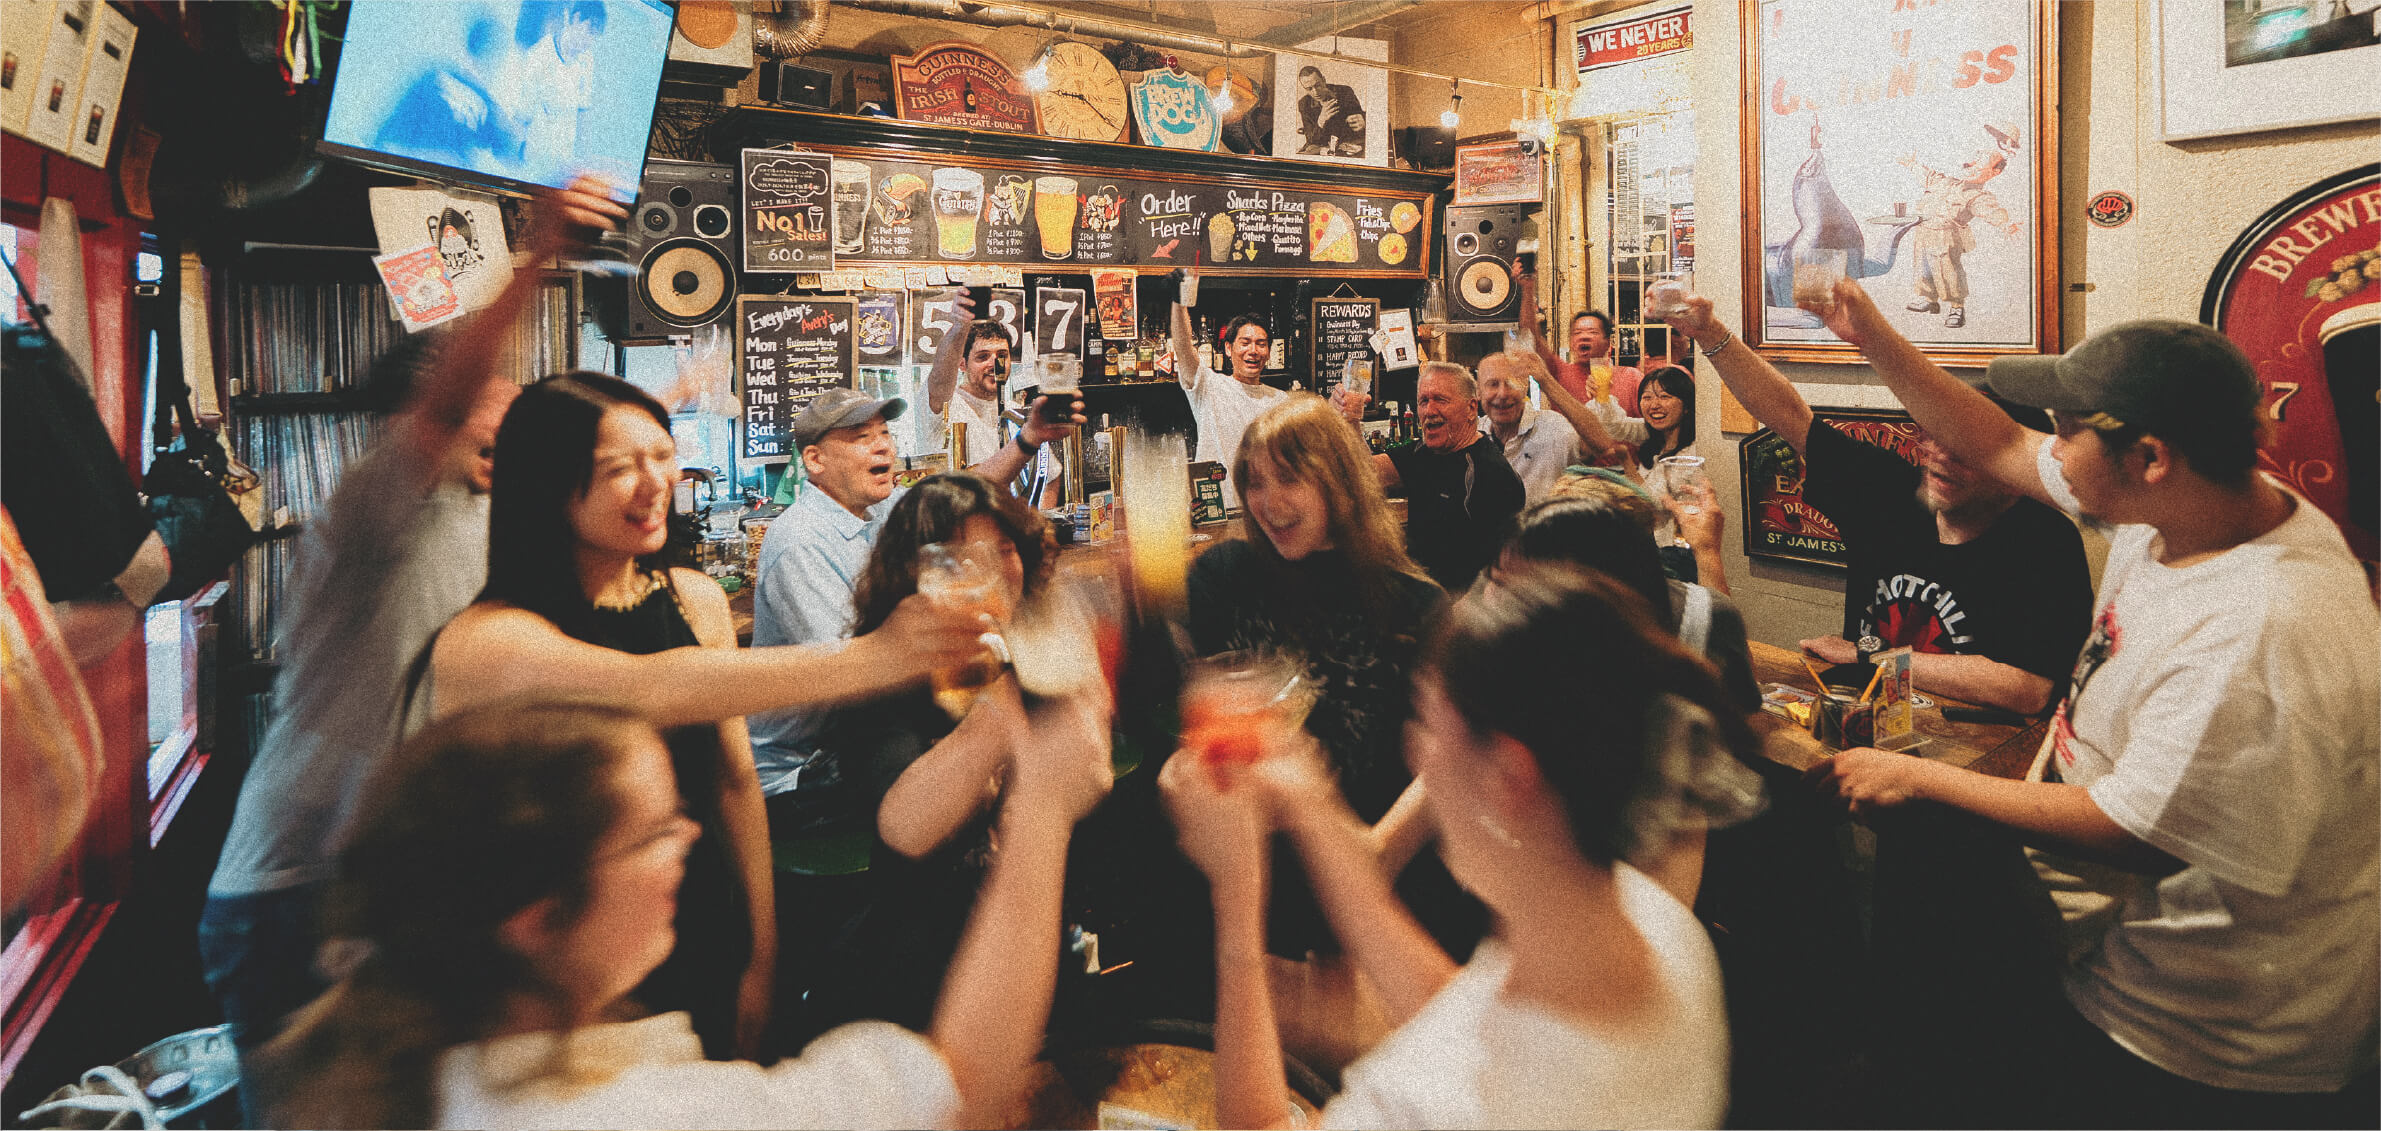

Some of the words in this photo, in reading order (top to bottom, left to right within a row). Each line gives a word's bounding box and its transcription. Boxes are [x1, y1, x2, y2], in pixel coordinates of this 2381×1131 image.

[1588, 30, 1618, 54] WE
[1620, 16, 1684, 48] NEVER
[919, 53, 1010, 86] GUINNESS
[931, 68, 961, 85] BOTTLED
[969, 69, 1002, 92] DRAUGHT
[908, 86, 927, 94] THE
[1146, 84, 1195, 106] BREW
[910, 87, 958, 109] IRISH
[979, 92, 1030, 120] STOUT
[1149, 104, 1198, 125] DOG
[969, 119, 990, 128] GATE
[994, 122, 1023, 130] DUBLIN
[1141, 189, 1197, 215] Order
[1226, 189, 1268, 210] Snacks
[1272, 192, 1305, 212] Pizza
[1356, 198, 1383, 217] Fries
[756, 210, 804, 232] No1
[787, 229, 828, 241] Sales!
[1242, 232, 1266, 242] Others
[768, 248, 804, 261] 600
[747, 303, 814, 333] Everyday's
[829, 318, 849, 335] Day
[1321, 304, 1372, 319] REWARDS
[918, 301, 953, 354] 5
[989, 300, 1019, 348] 3
[1044, 300, 1078, 350] 7
[746, 337, 777, 353] Mon
[1326, 335, 1346, 344] STAMP
[1347, 334, 1363, 343] CARD
[746, 355, 775, 371] Tue
[1326, 351, 1345, 361] HAPPY
[746, 371, 777, 387] Wed
[747, 389, 779, 405] Thu
[2269, 381, 2300, 421] 7
[747, 406, 774, 423] Fri
[748, 423, 776, 438] Sat
[748, 439, 778, 456] Sun
[1775, 474, 1806, 496] EX
